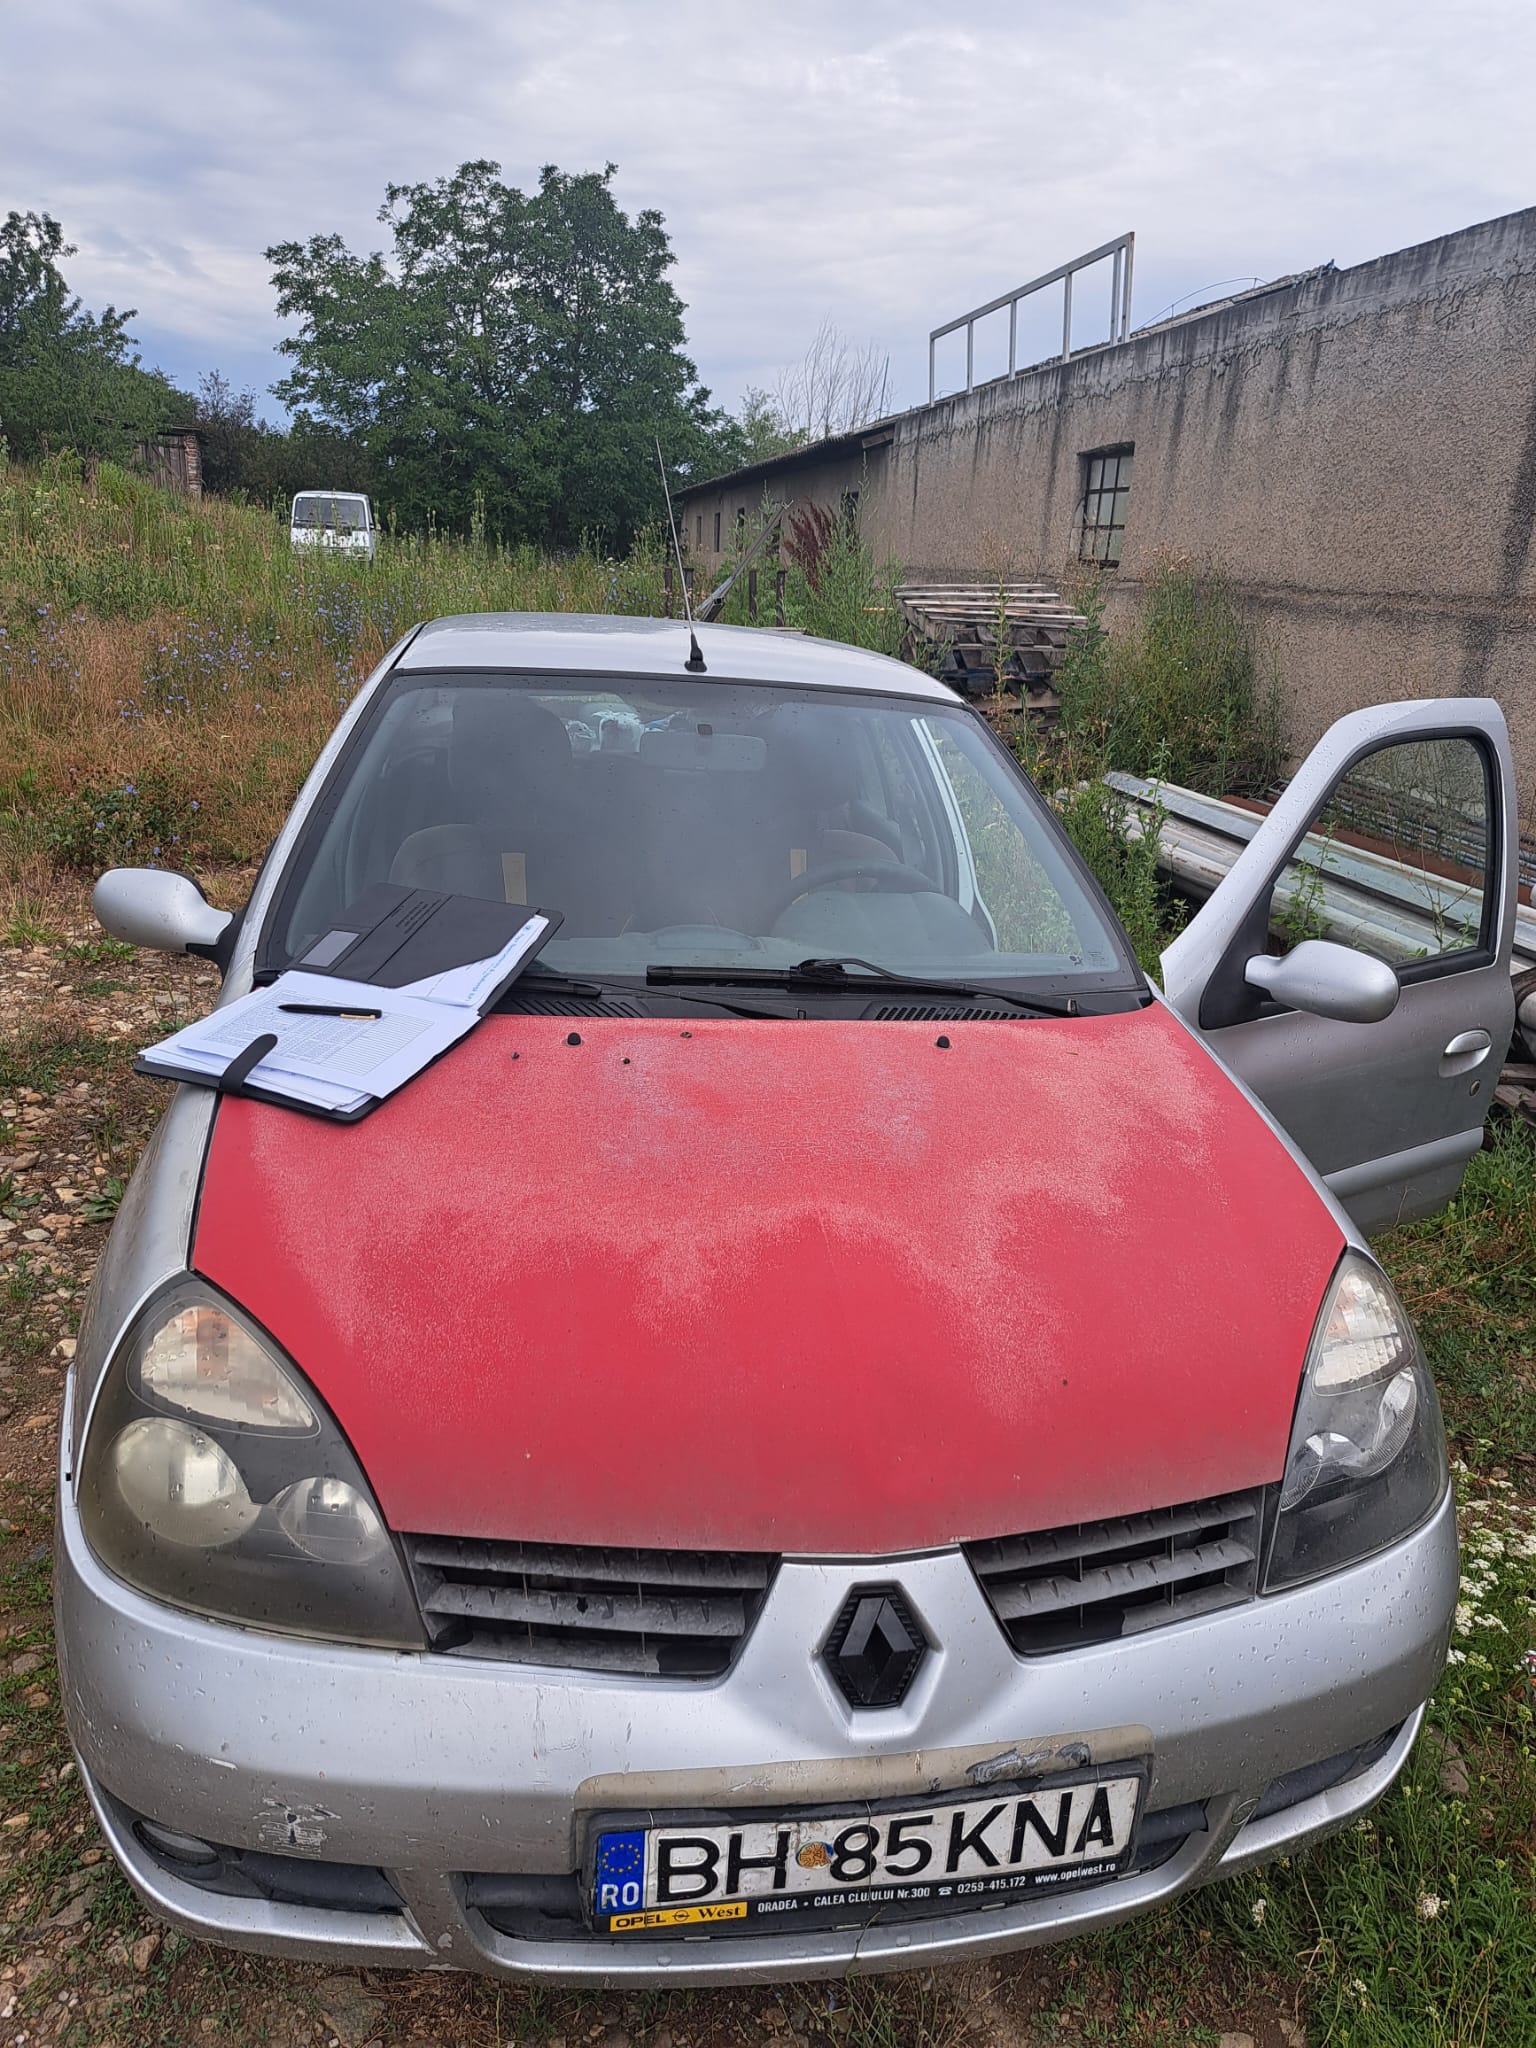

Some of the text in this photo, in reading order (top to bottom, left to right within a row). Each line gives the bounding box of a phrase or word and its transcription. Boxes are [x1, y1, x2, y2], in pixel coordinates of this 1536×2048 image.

[657, 1831, 790, 1902] BH
[600, 1882, 640, 1909] RO
[757, 1899, 798, 1913] ORADEA
[813, 1894, 845, 1907] CALEA
[1034, 1863, 1116, 1884] www.opelwest.ro
[615, 1904, 742, 1928] OPEL West
